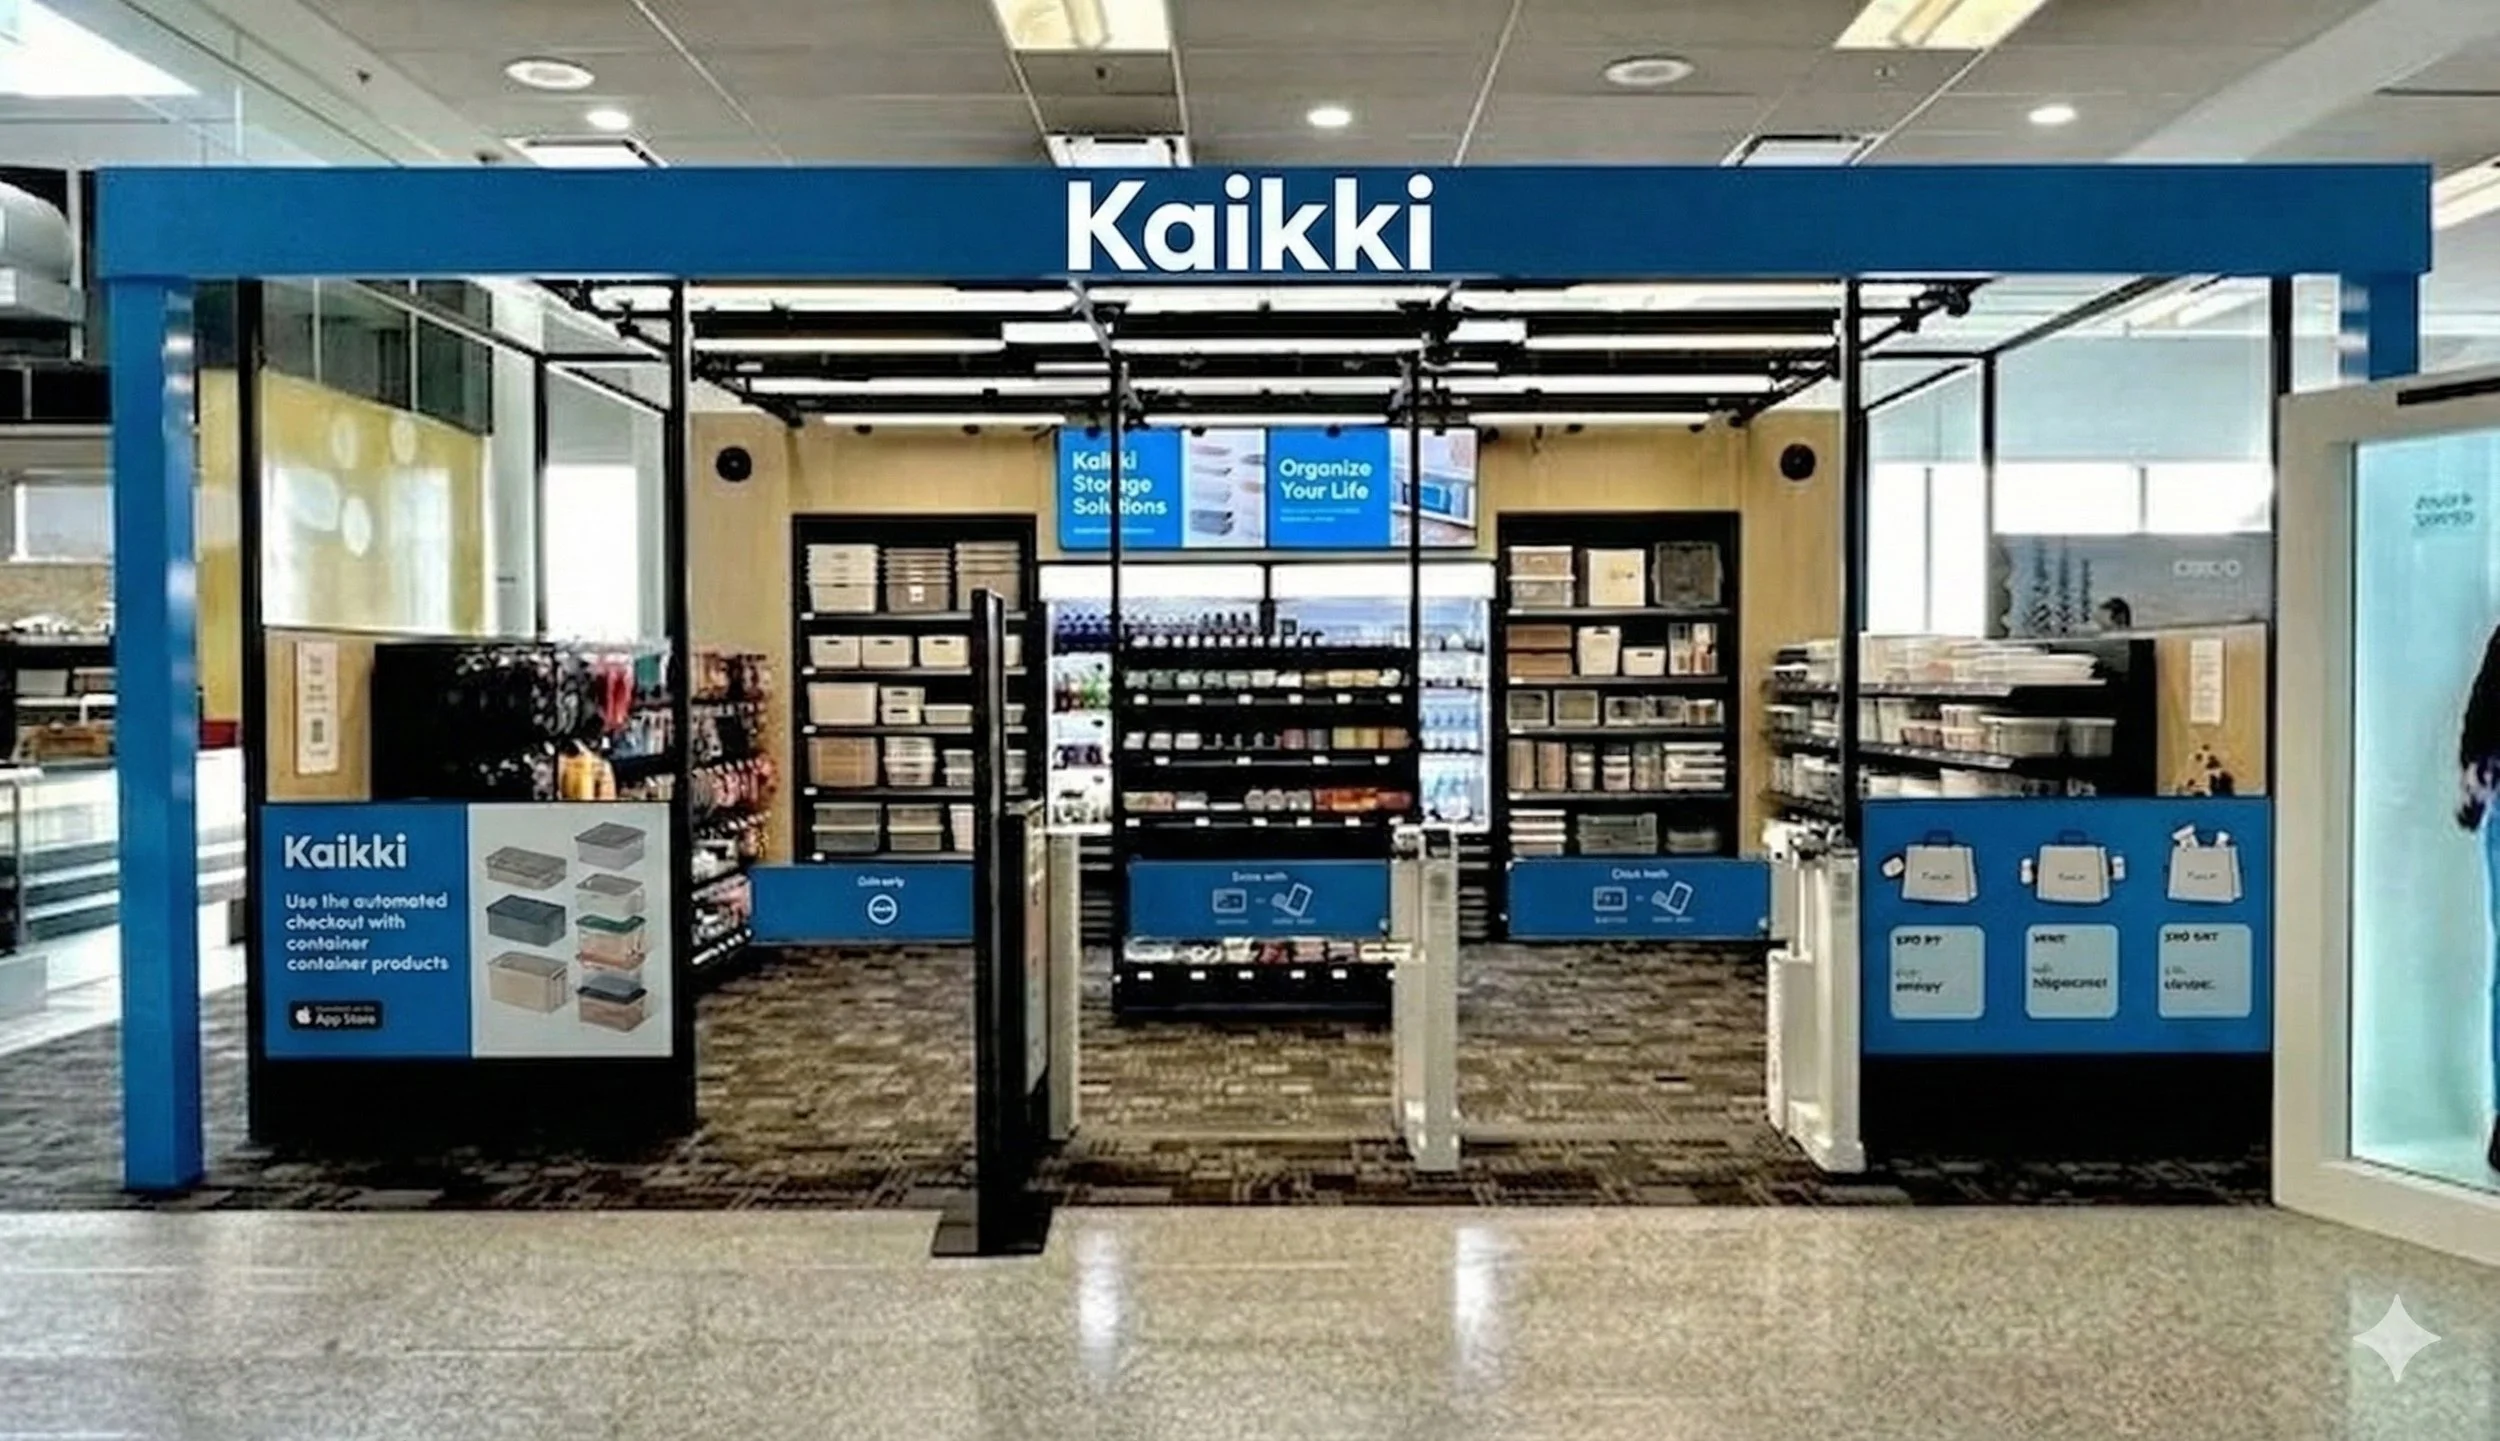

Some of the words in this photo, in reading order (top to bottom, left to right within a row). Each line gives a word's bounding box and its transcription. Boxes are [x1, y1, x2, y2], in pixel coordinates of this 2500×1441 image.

[1067, 173, 1434, 272] Kaikki
[1279, 458, 1373, 481] Organize
[1280, 481, 1327, 500] Your
[1331, 481, 1369, 500] Life
[284, 833, 407, 869] Kaikki
[286, 894, 317, 909] Use
[321, 893, 349, 909] the
[352, 892, 448, 909] automated
[285, 913, 364, 930] checkout
[368, 913, 406, 930] with
[286, 935, 369, 951] container
[286, 956, 368, 971] container
[371, 955, 449, 975] products
